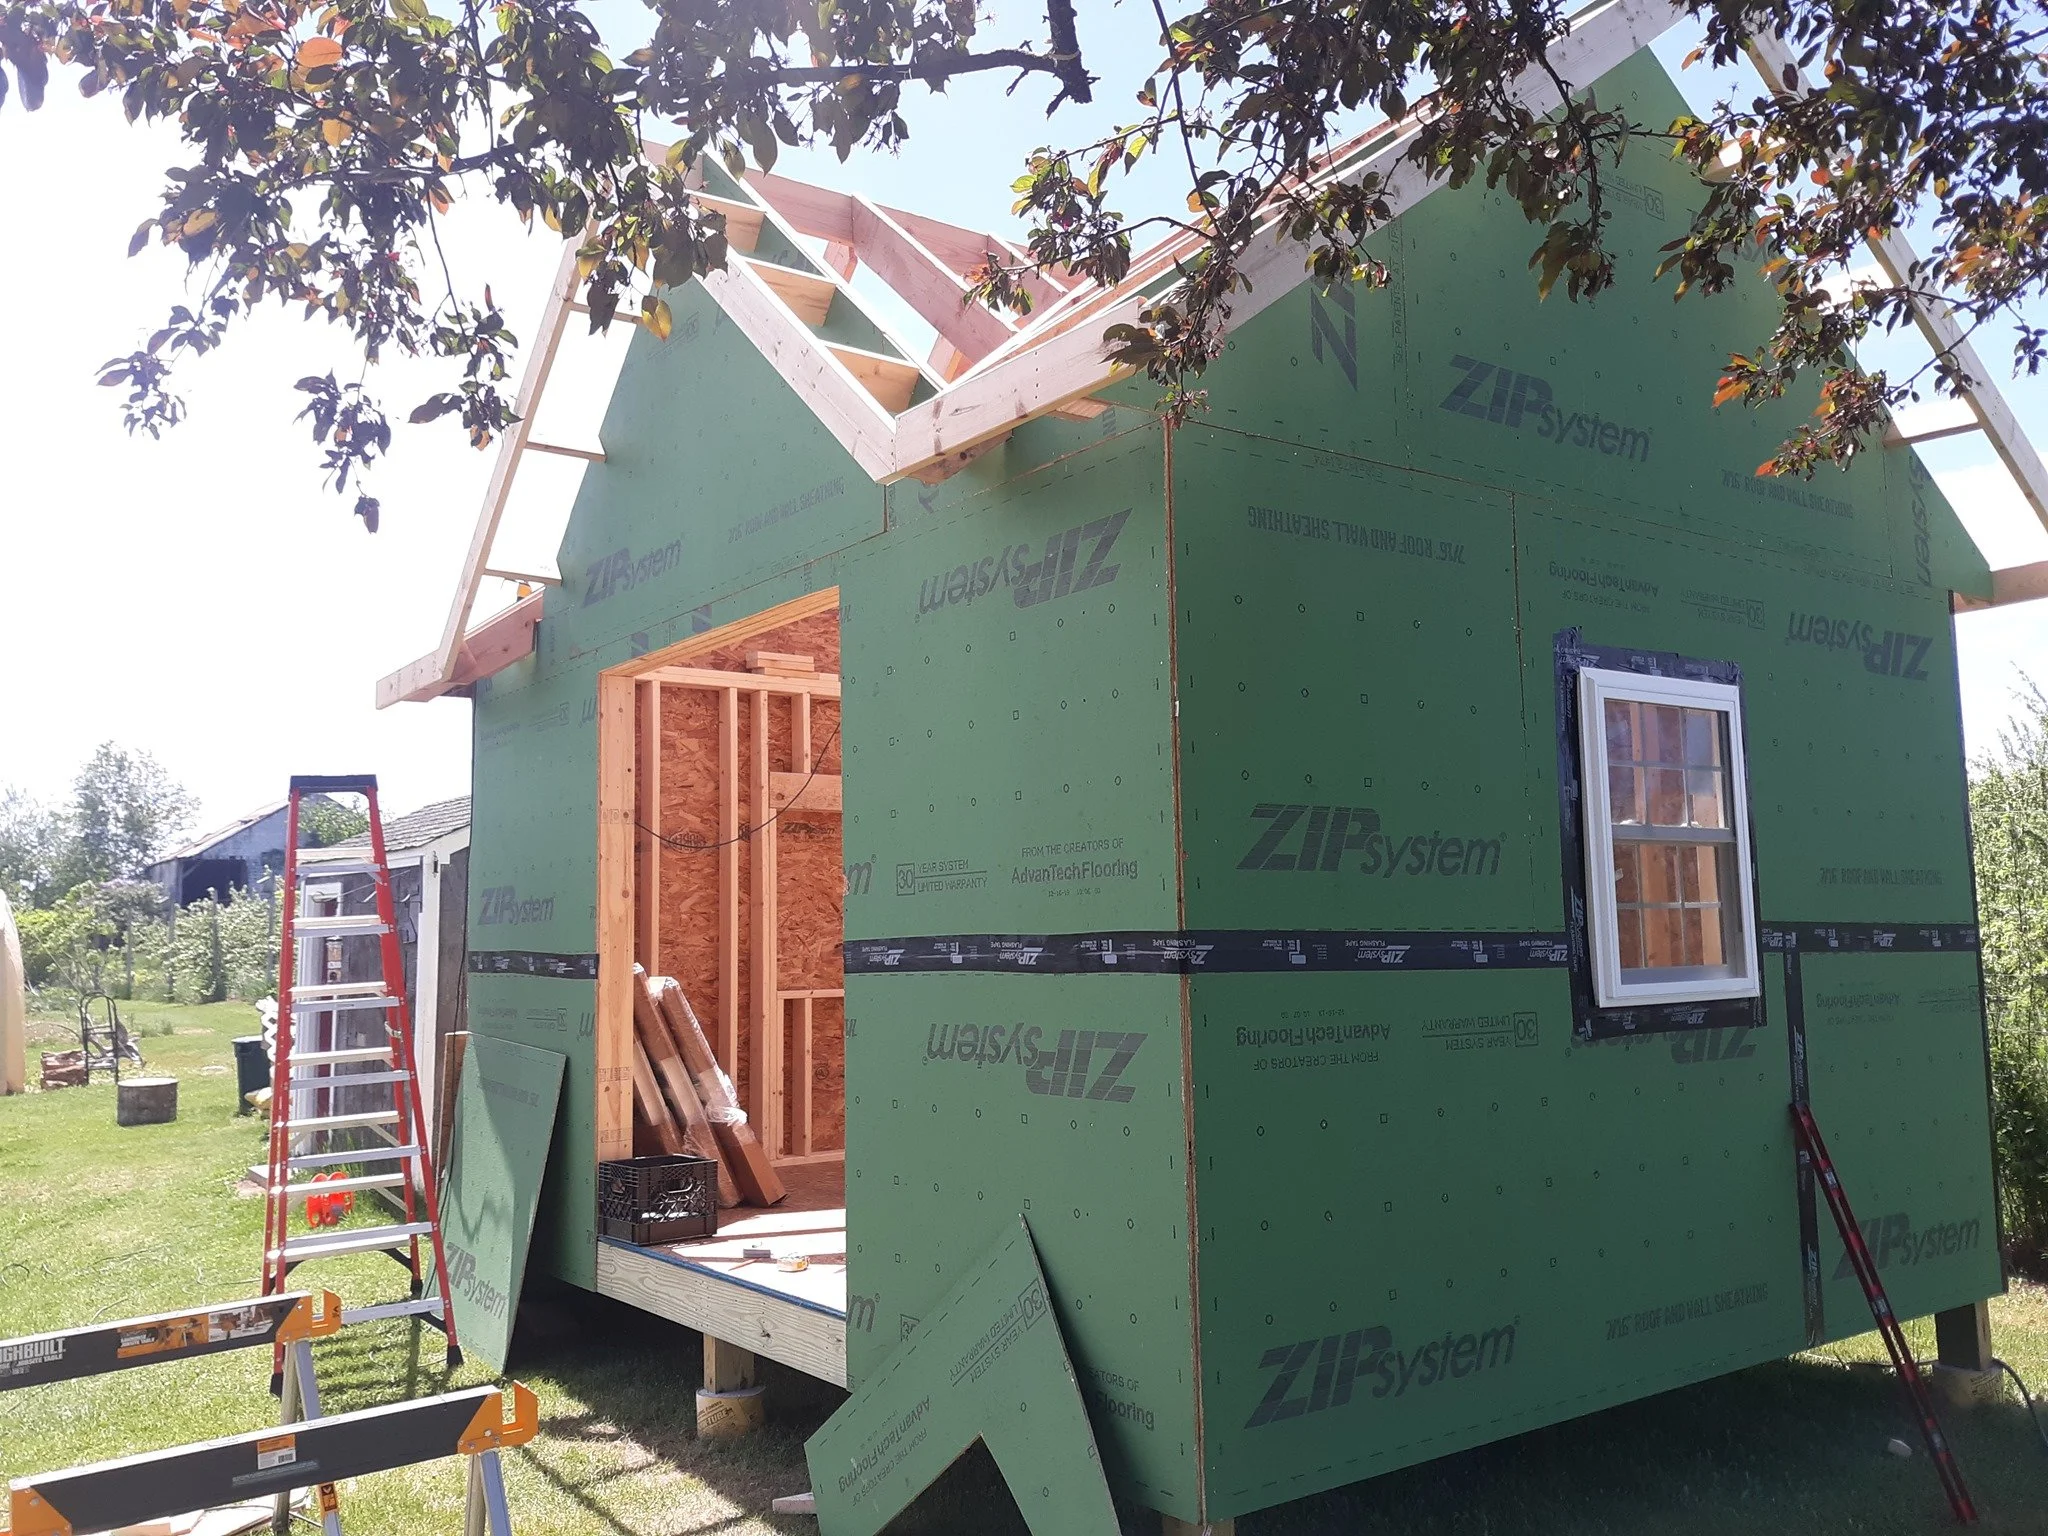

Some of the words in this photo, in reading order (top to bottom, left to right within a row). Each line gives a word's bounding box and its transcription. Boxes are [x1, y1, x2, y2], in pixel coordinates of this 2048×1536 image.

[1247, 505, 1331, 541] SHEATHING
[1370, 528, 1396, 552] AND
[1021, 846, 1044, 858] FROM
[1045, 844, 1062, 856] THE
[1063, 841, 1110, 855] CREATORS
[1112, 837, 1125, 850] OF
[917, 861, 938, 874] YEAR
[939, 859, 970, 873] SYSTEM
[898, 869, 914, 889] 30
[1420, 1016, 1476, 1031] WARRANTY
[1477, 1015, 1511, 1029] LIMITED
[1516, 1018, 1537, 1041] 30
[1445, 1038, 1485, 1051] SYSTEM
[1487, 1035, 1512, 1048] YEAR
[1252, 1057, 1267, 1070] OF
[1270, 1054, 1327, 1069] CREATORS
[1329, 1052, 1349, 1065] THE
[1350, 1051, 1380, 1063] FROM
